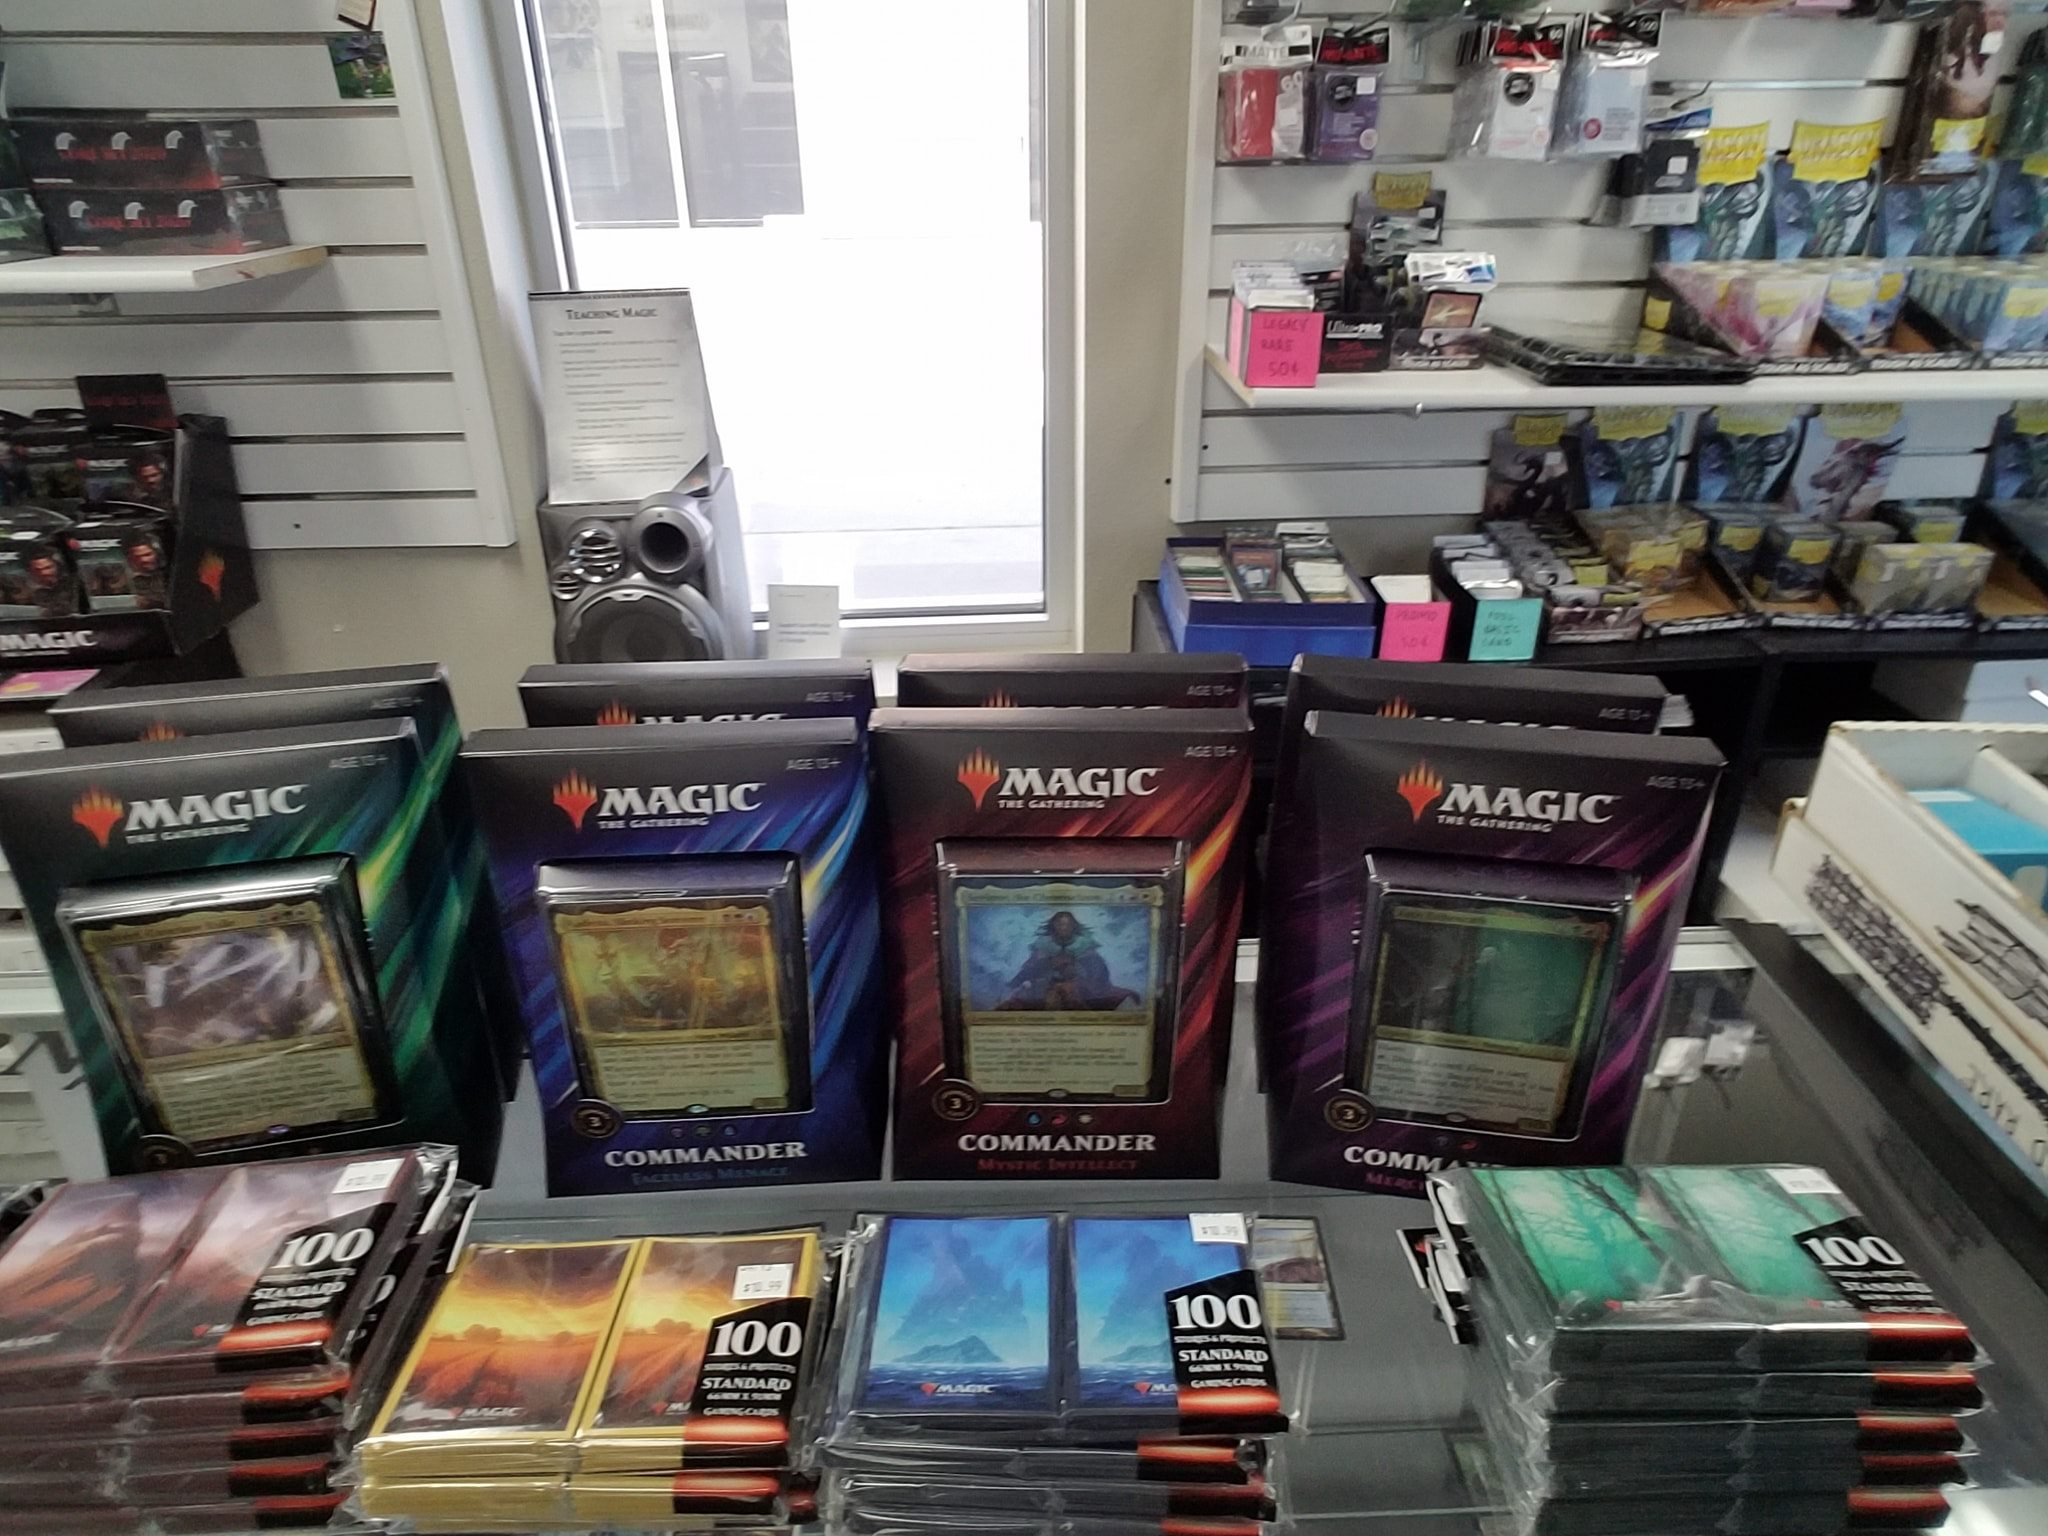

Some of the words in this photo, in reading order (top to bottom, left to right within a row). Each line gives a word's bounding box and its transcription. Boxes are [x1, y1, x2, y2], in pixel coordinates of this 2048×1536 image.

[0, 629, 99, 650] MAGIC
[1186, 685, 1212, 697] AGE
[1184, 745, 1212, 758] AGE
[786, 758, 815, 771] AGE
[998, 766, 1164, 797] MAGIC
[124, 784, 311, 832] MAGIC
[598, 782, 766, 816] MAGIC
[998, 799, 1025, 809] THE
[1028, 799, 1105, 809] GATHERING
[1437, 783, 1622, 824] MAGIC
[599, 819, 627, 830] THE
[630, 816, 709, 829] GATHERING
[1437, 814, 1467, 827] THE
[1470, 818, 1553, 833] GATHERING
[957, 1133, 1156, 1152] COMMANDER
[604, 1141, 809, 1168] COMMANDER
[269, 1227, 375, 1270] 100
[1801, 1235, 1906, 1266] 100
[1168, 1294, 1263, 1330] 100
[706, 1320, 803, 1357] 100
[1178, 1349, 1269, 1364] STANDARD
[700, 1376, 792, 1392] STANDARD
[936, 1383, 999, 1394] MAGIC
